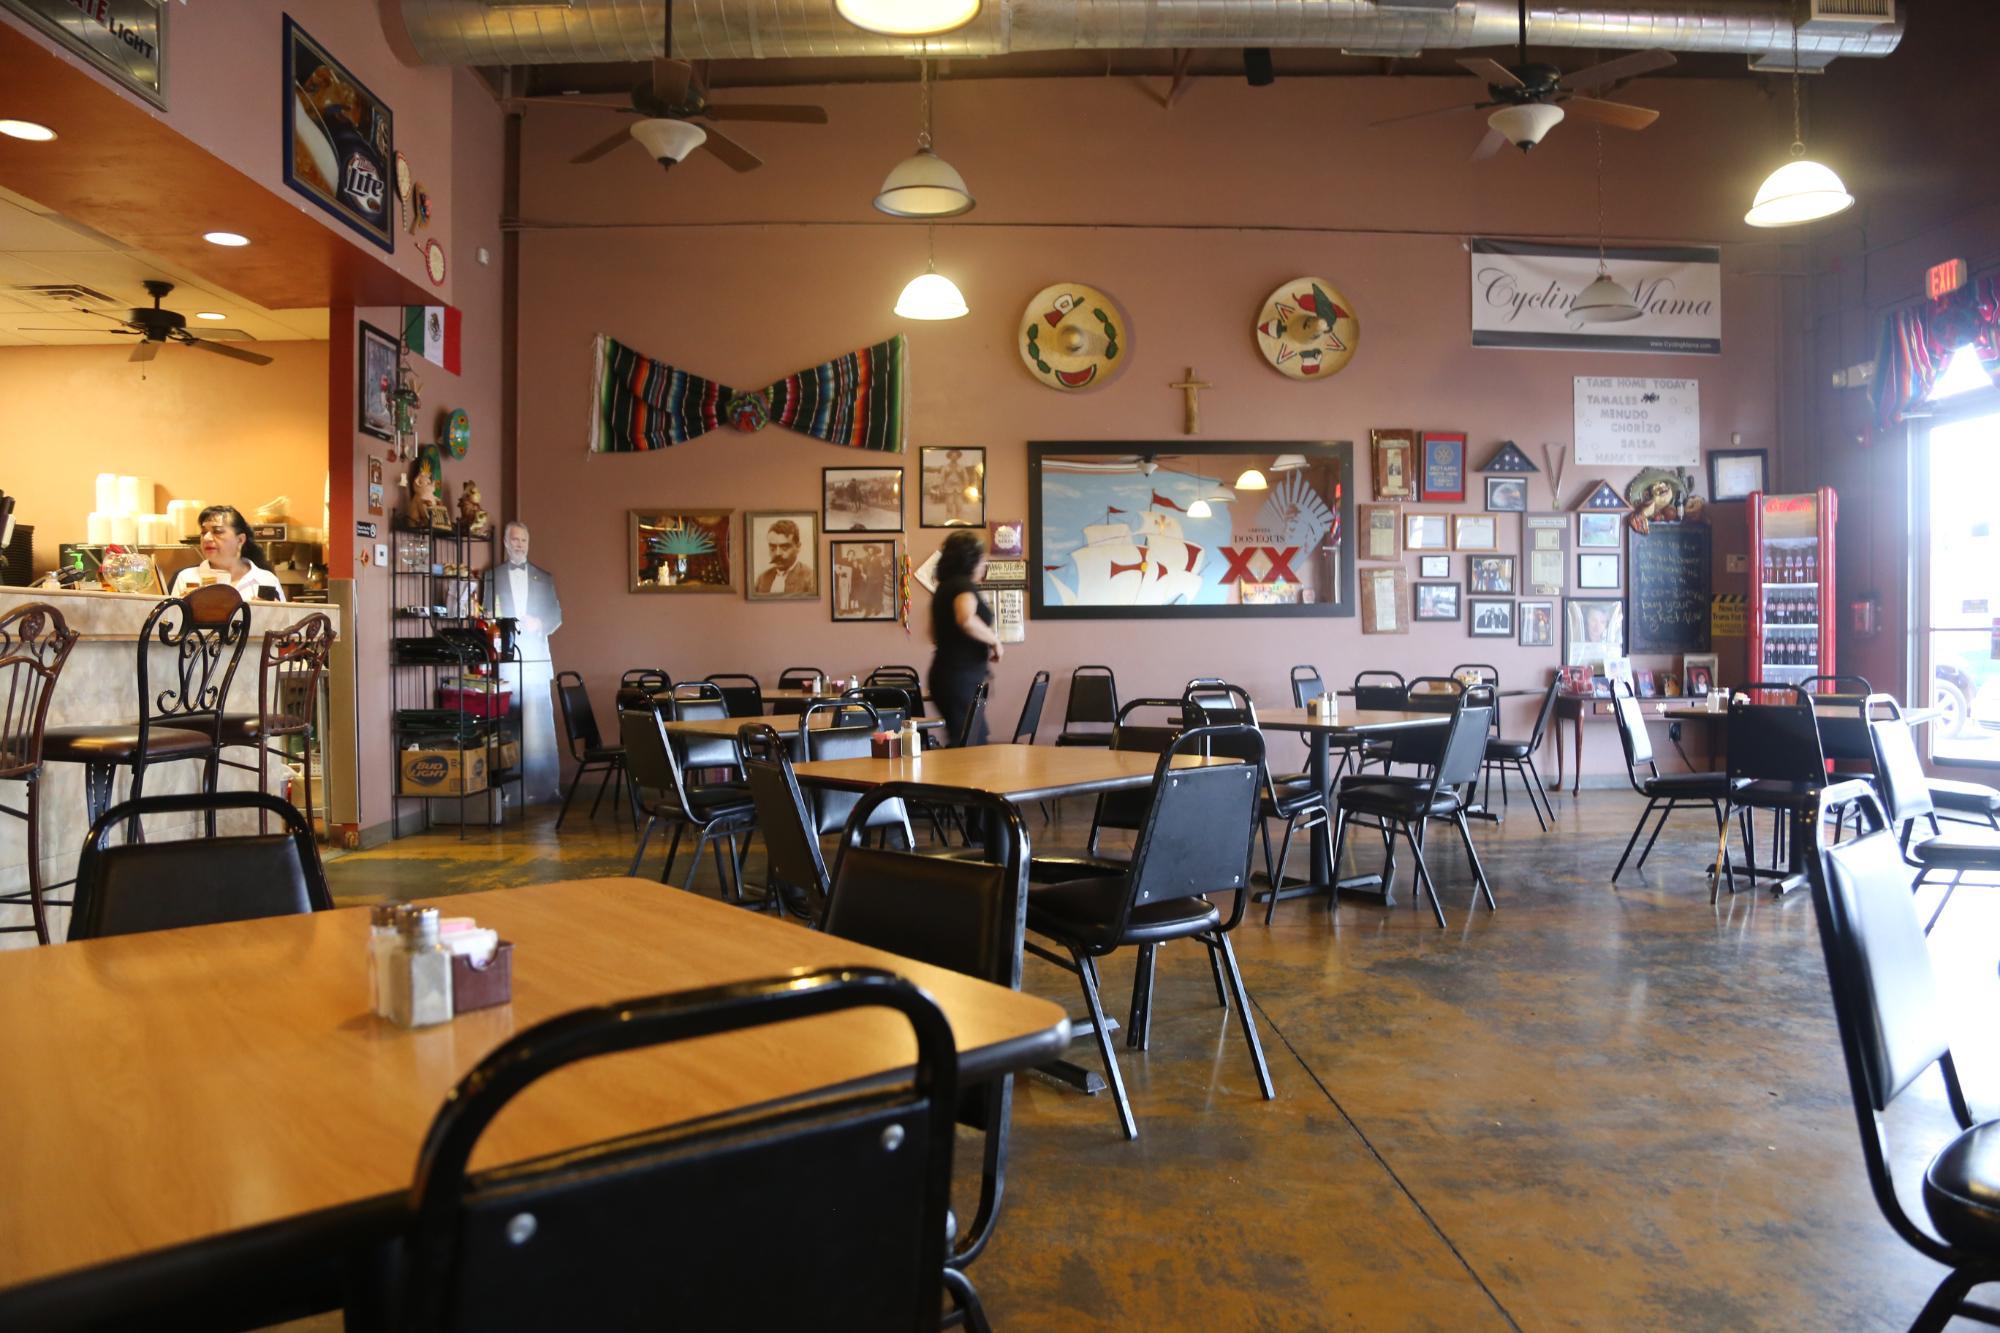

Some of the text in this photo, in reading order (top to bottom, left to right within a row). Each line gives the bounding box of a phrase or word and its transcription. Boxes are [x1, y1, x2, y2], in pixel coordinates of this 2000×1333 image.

[109, 17, 154, 59] LIGHT
[345, 167, 384, 198] Lite
[1931, 259, 1958, 297] EXIT
[1477, 267, 1586, 331] Cyclin
[1587, 379, 1688, 391] TAKE HOME TODAY
[1587, 395, 1638, 406] TAMALES
[1600, 408, 1649, 420] MENUDO
[1621, 440, 1656, 449] SALSA
[1234, 534, 1286, 544] DOS EQUIS
[1218, 546, 1301, 584] XX
[416, 762, 444, 770] BUD
[412, 770, 447, 778] LIGHT
